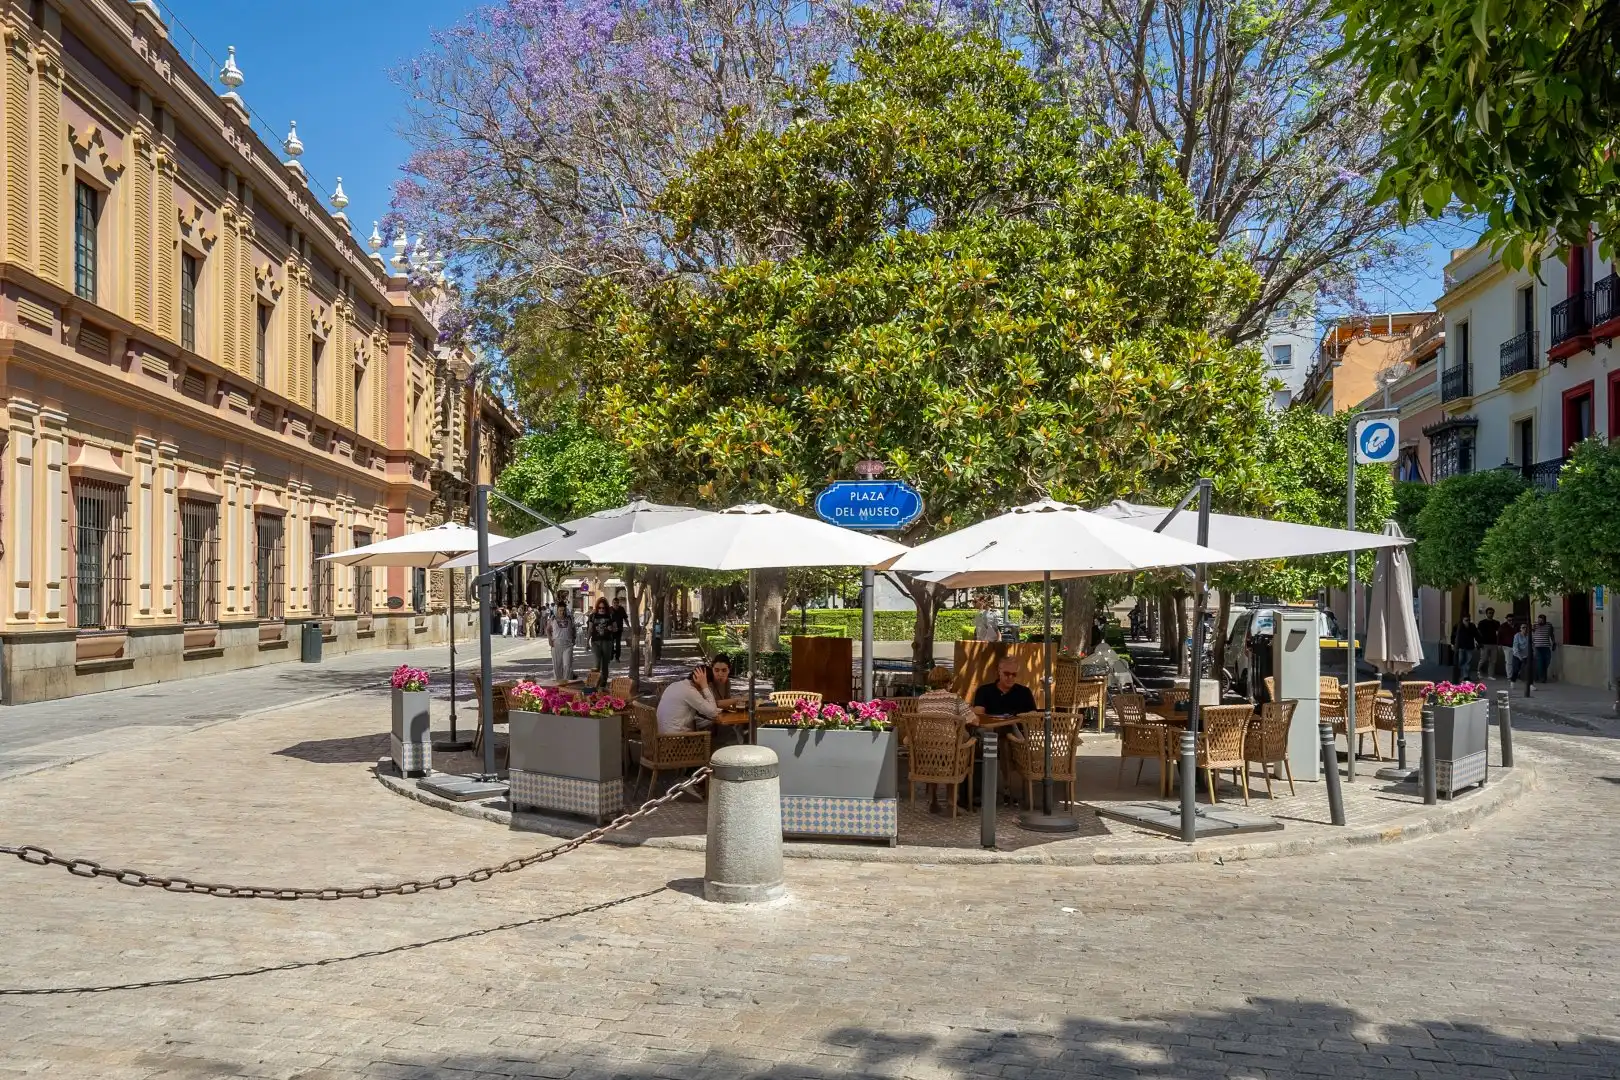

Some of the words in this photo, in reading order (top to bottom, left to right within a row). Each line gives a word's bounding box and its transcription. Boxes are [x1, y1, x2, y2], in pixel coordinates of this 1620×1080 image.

[850, 491, 885, 501] PLAZA
[835, 507, 854, 517] DEL
[858, 507, 900, 517] MUSEO
